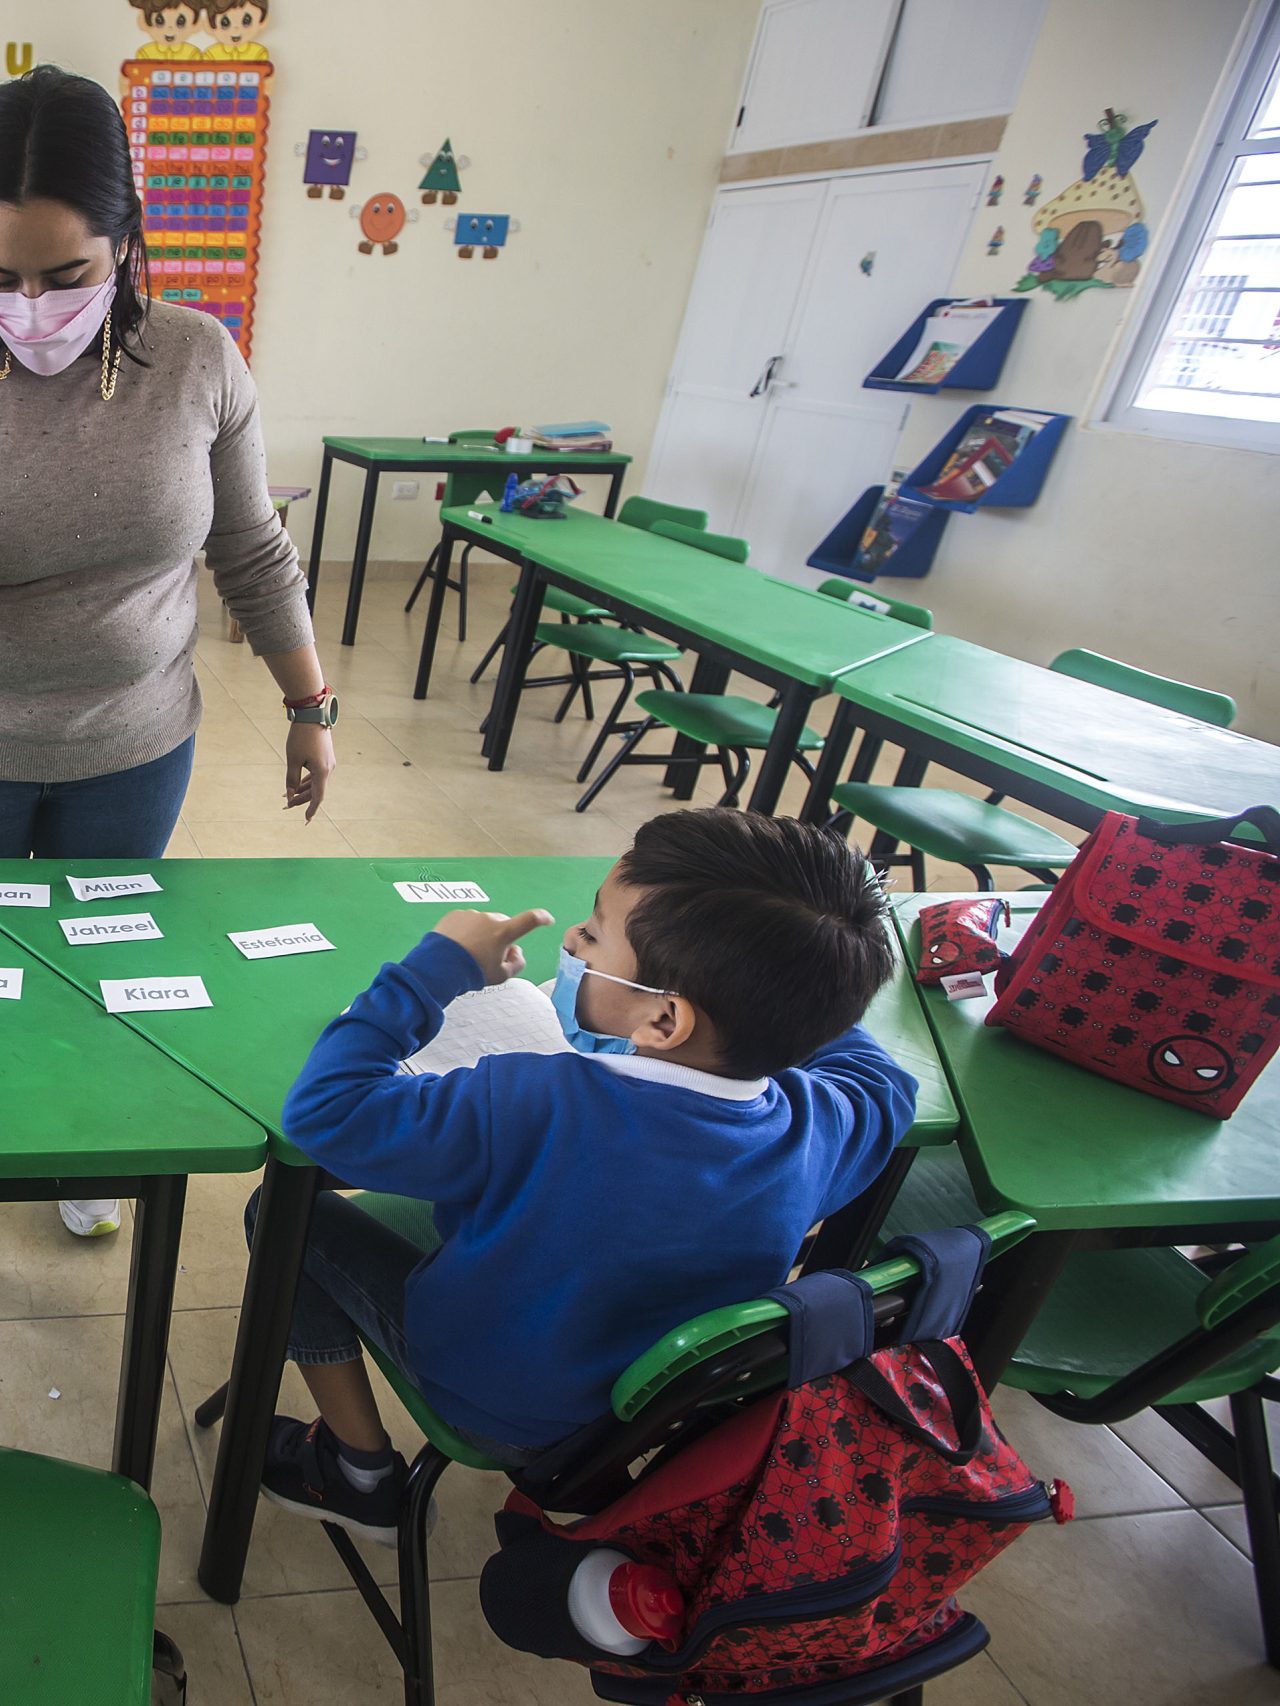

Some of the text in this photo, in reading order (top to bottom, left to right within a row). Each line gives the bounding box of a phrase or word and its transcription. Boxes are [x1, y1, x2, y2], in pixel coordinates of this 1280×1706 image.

[85, 879, 143, 894] Milan
[406, 883, 486, 900] Milan
[68, 920, 156, 937] Jahzeel
[238, 931, 323, 951] Estefanía
[124, 986, 190, 1001] Kiara
